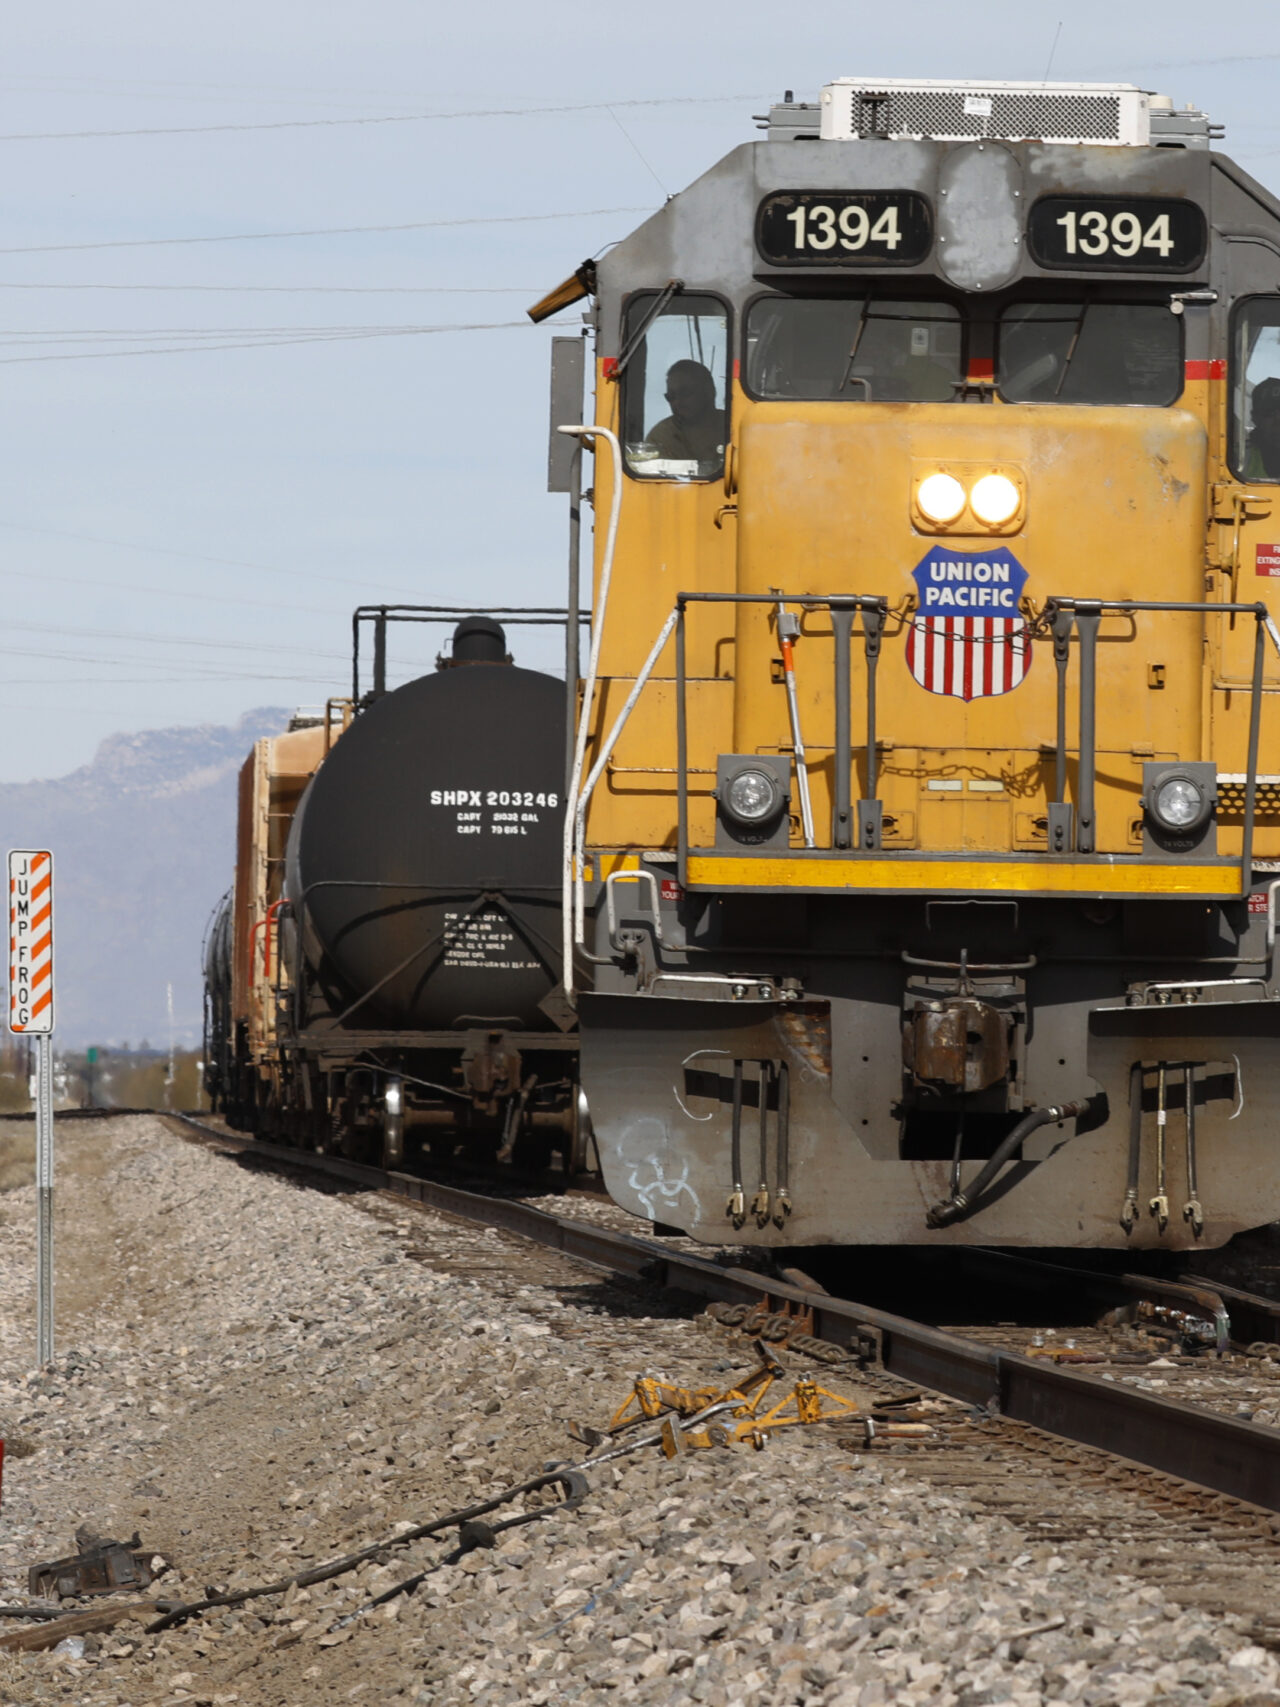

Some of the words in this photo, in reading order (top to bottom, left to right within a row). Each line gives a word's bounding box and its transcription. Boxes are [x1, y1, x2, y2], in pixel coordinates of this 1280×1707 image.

[786, 205, 902, 250] 1394
[1056, 210, 1174, 257] 1394
[930, 562, 1010, 582] UNION
[926, 587, 1013, 607] PACIFIC
[430, 791, 482, 806] SHPX
[486, 791, 558, 807] 203246
[457, 812, 481, 821] CAPY
[521, 813, 539, 822] GAL
[457, 825, 481, 834] CAPY
[18, 859, 29, 937] JUMP
[1255, 903, 1269, 912] STE
[18, 946, 29, 1024] FROG
